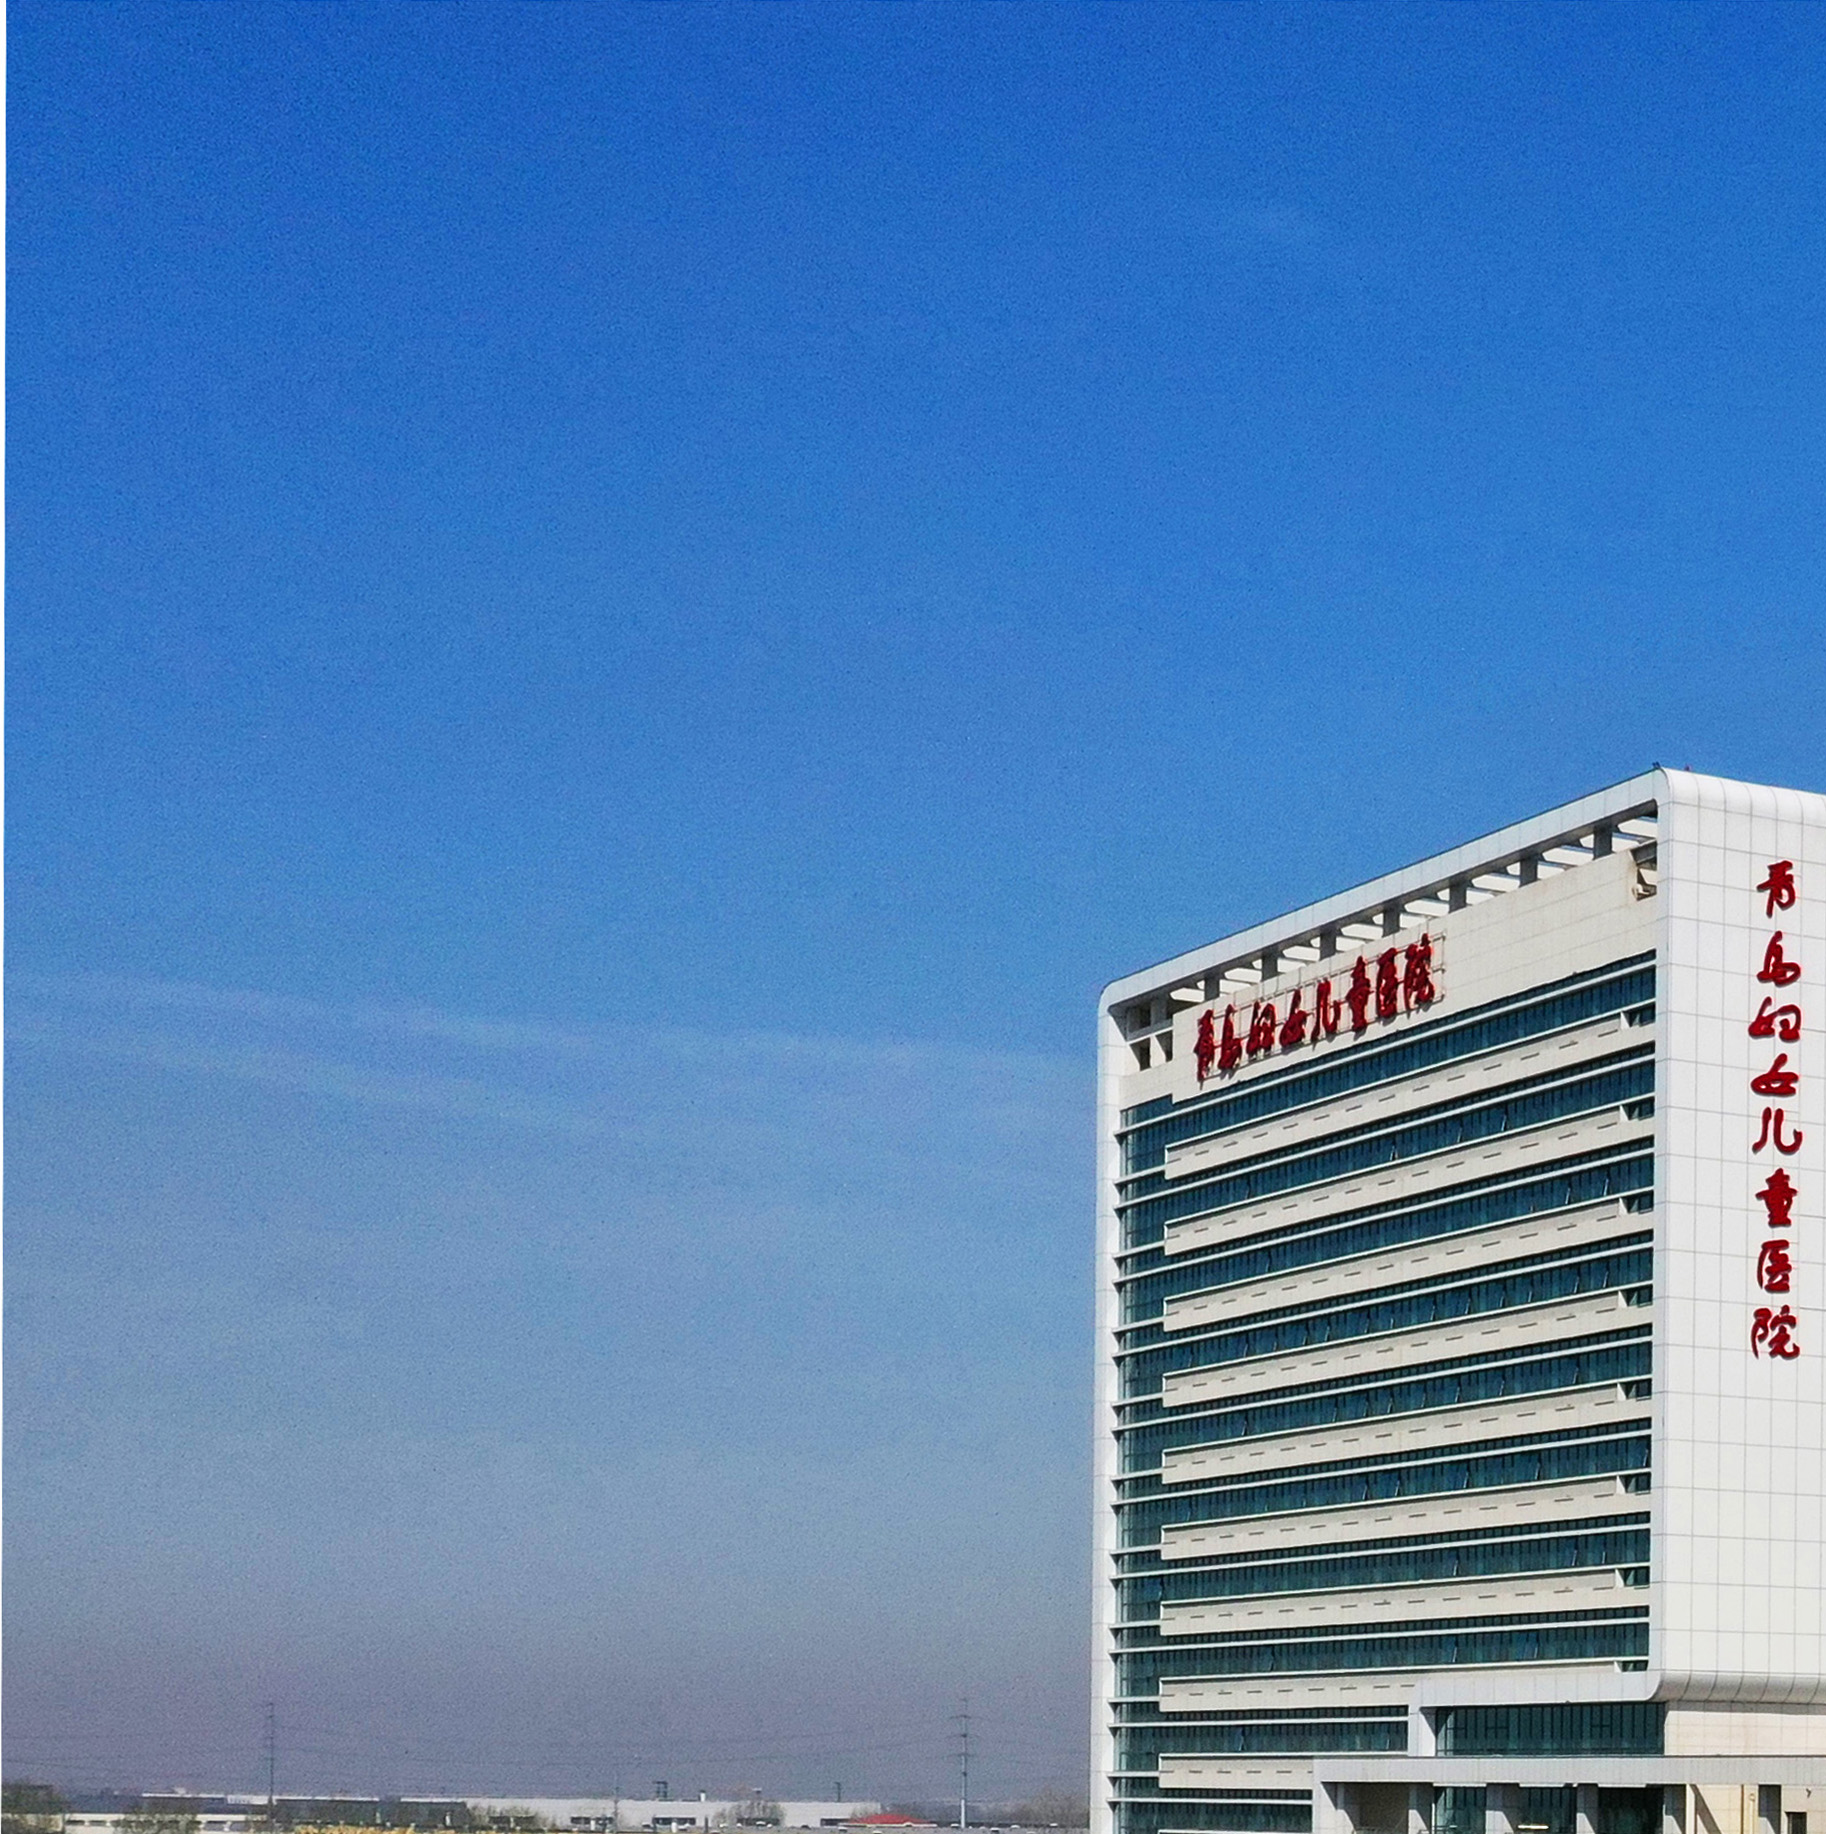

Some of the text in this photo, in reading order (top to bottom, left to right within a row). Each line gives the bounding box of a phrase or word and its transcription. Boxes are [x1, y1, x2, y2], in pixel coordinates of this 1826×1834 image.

[1194, 933, 1436, 1082] 青岛妇女儿童医院
[1748, 860, 1804, 1360] 青岛妇女儿童医院
